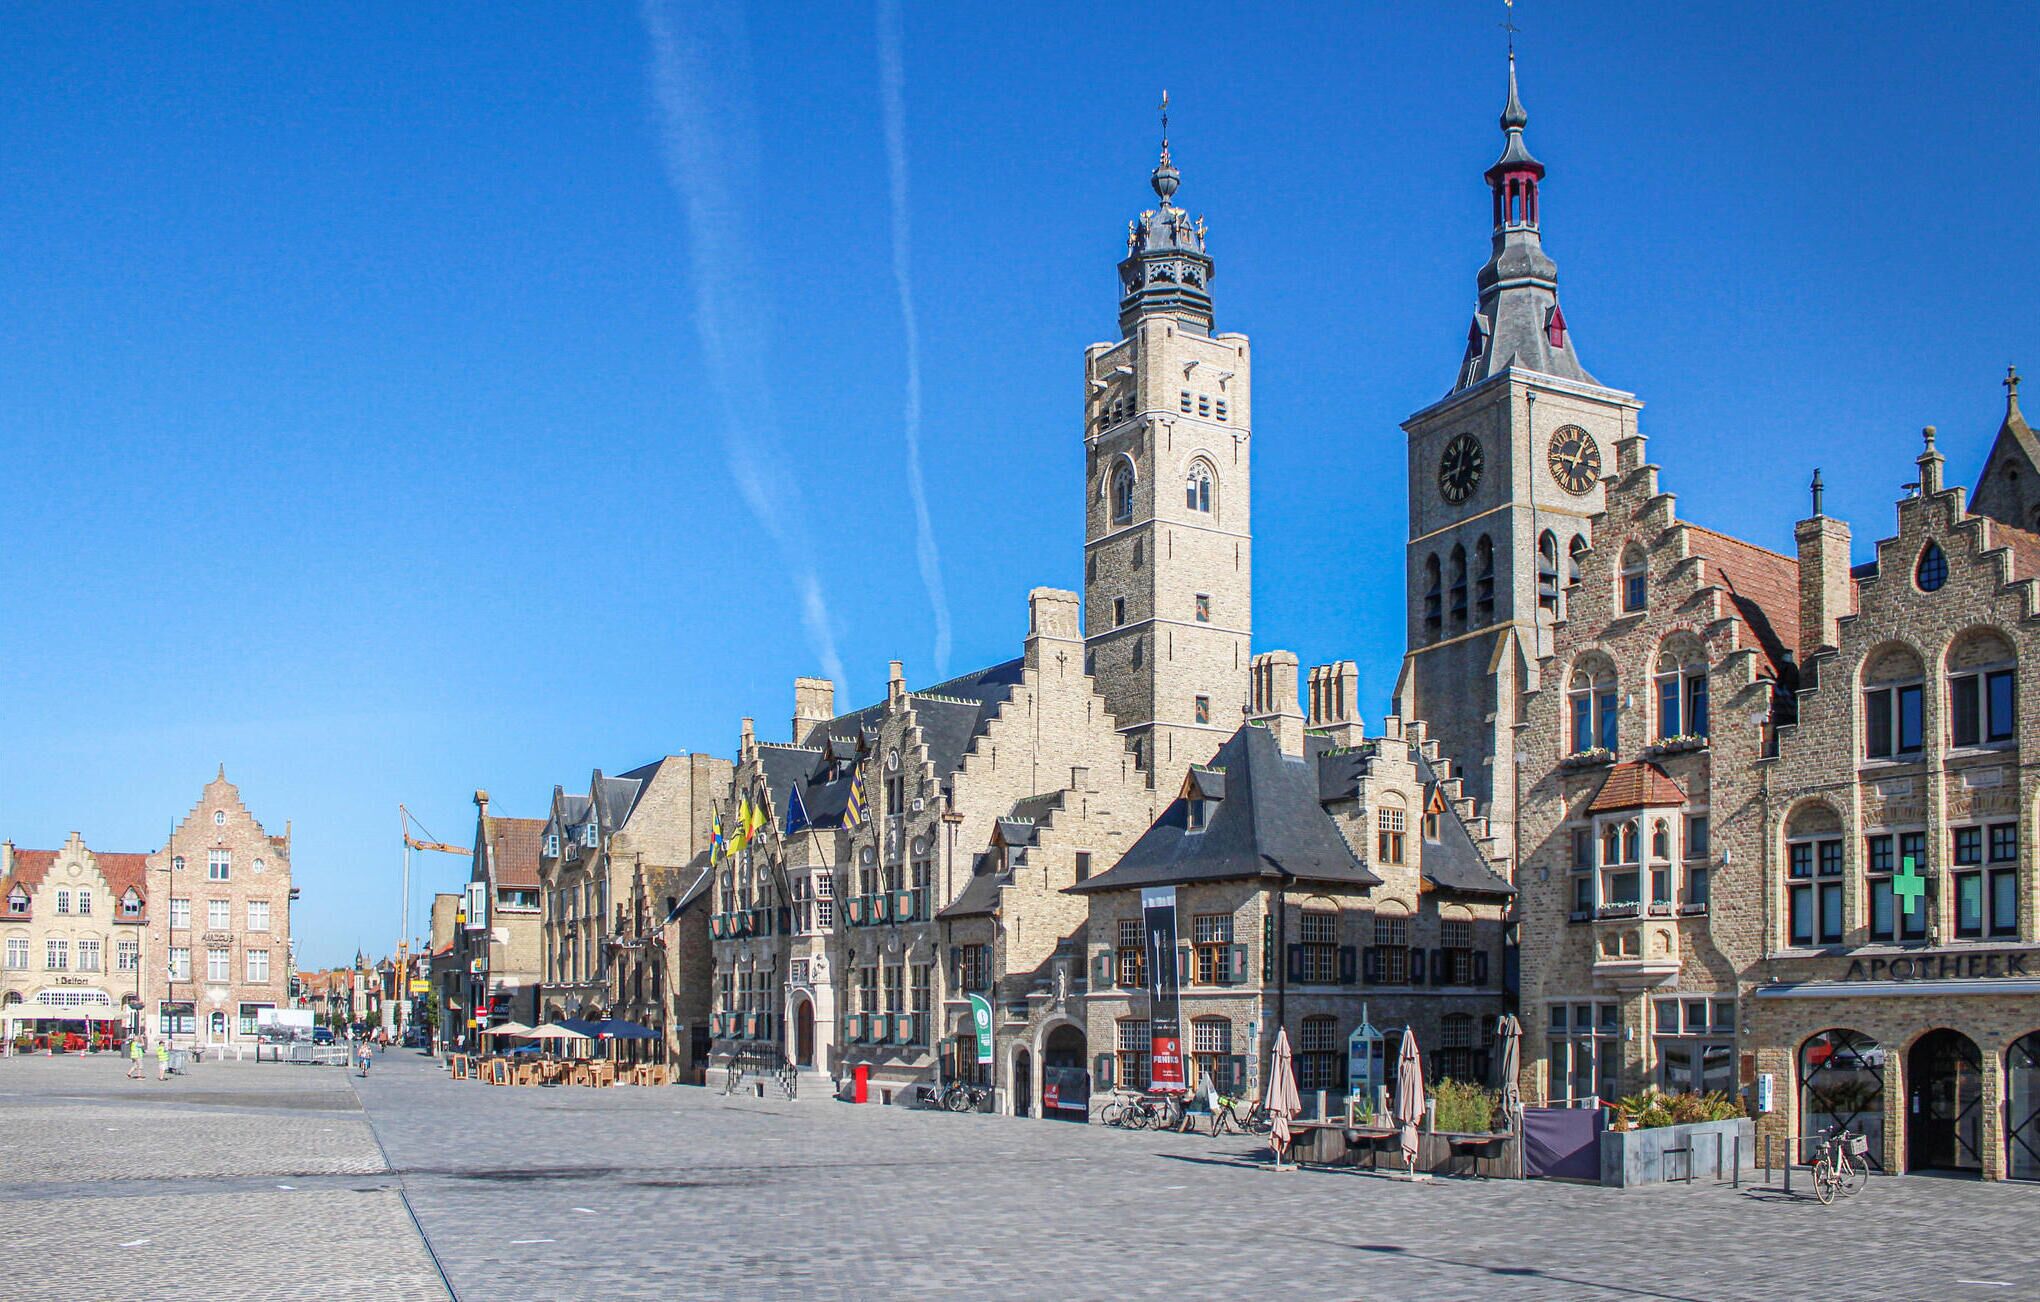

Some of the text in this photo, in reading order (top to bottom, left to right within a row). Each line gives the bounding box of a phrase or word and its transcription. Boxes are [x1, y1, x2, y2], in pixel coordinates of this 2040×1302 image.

[1846, 953, 2027, 981] APOTHEEK
[61, 976, 88, 985] Belfort
[1153, 1055, 1179, 1064] FENIKS
